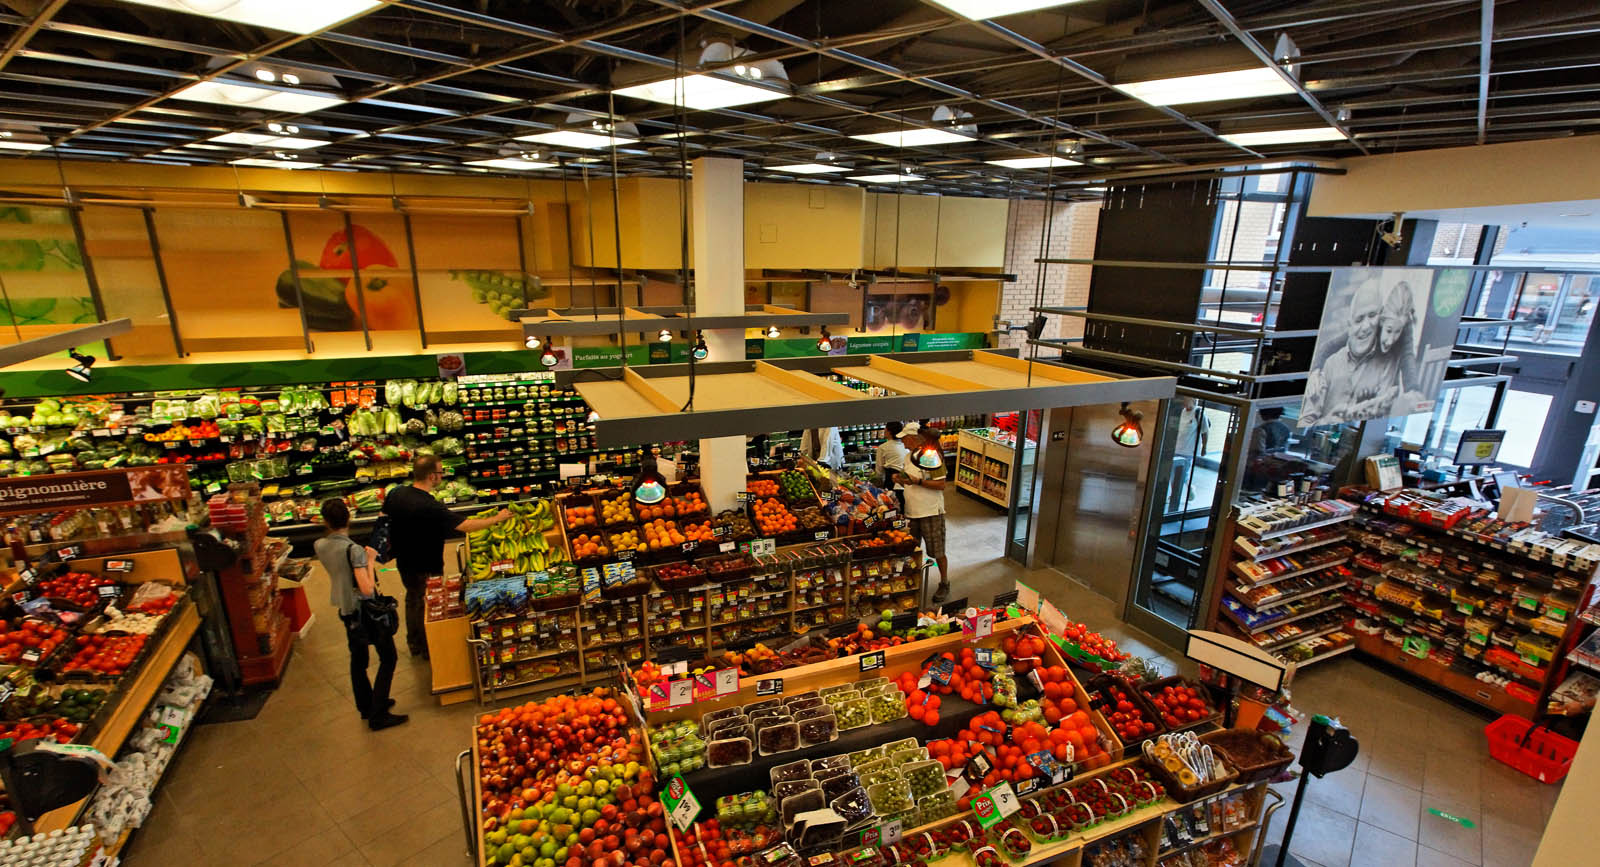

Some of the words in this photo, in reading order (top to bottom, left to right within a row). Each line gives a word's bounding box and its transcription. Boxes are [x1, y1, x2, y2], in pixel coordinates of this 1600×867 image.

[575, 353, 600, 361] Parfaits
[976, 799, 992, 811] Prix
[864, 831, 879, 841] Prix
